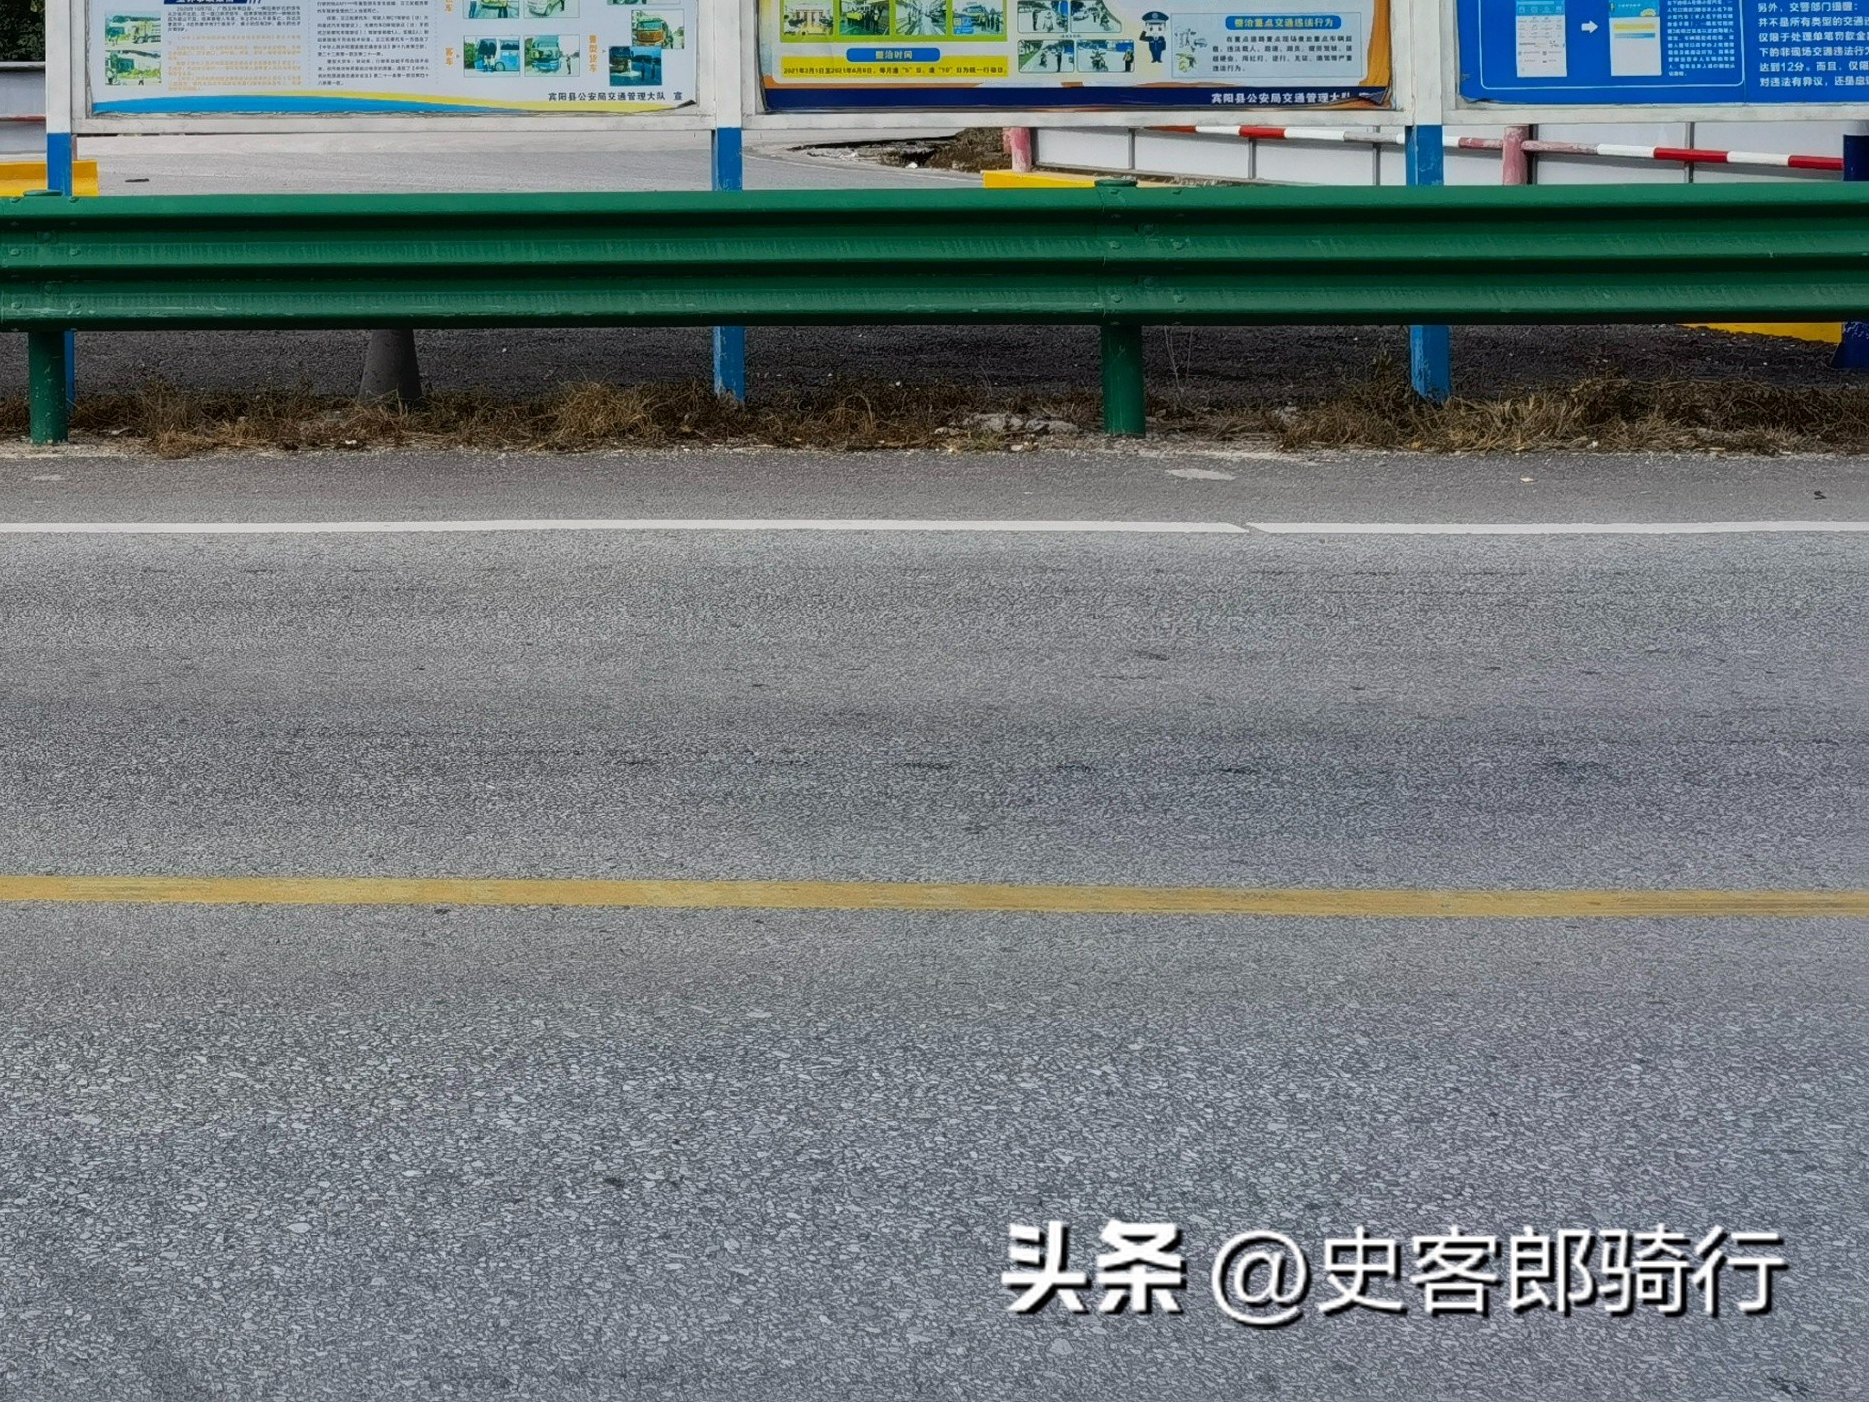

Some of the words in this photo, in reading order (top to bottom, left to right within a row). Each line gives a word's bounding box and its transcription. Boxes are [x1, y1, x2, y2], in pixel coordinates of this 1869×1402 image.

[1759, 30, 1869, 42] 仅限于处理单笔罚款金
[875, 50, 913, 60] 整治时间
[548, 91, 666, 101] 宾阳县公安局交通管理大队
[673, 91, 683, 101] 宣
